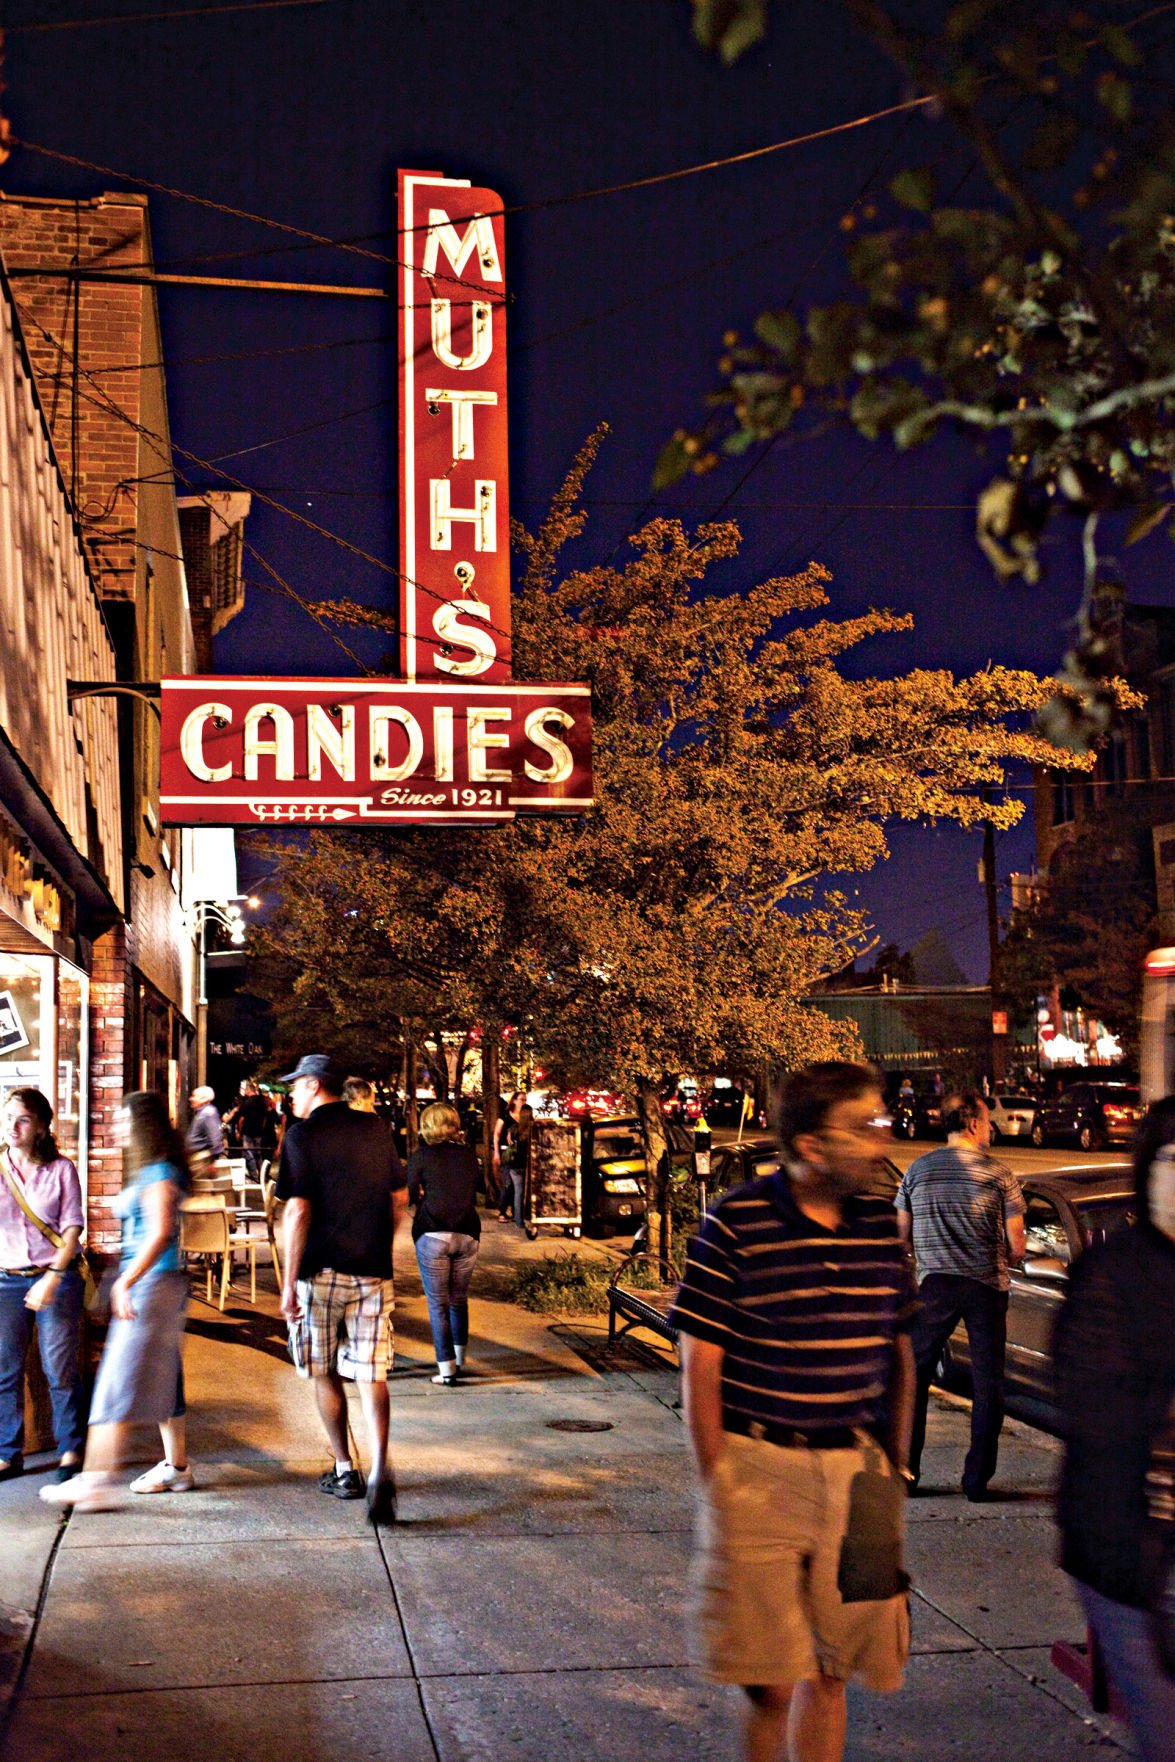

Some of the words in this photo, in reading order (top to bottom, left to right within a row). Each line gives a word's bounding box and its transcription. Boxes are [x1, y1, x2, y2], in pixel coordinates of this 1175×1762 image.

[422, 208, 502, 677] MUTH'S
[180, 702, 576, 783] CANDIES
[380, 787, 447, 805] Since
[451, 788, 502, 806] 1921
